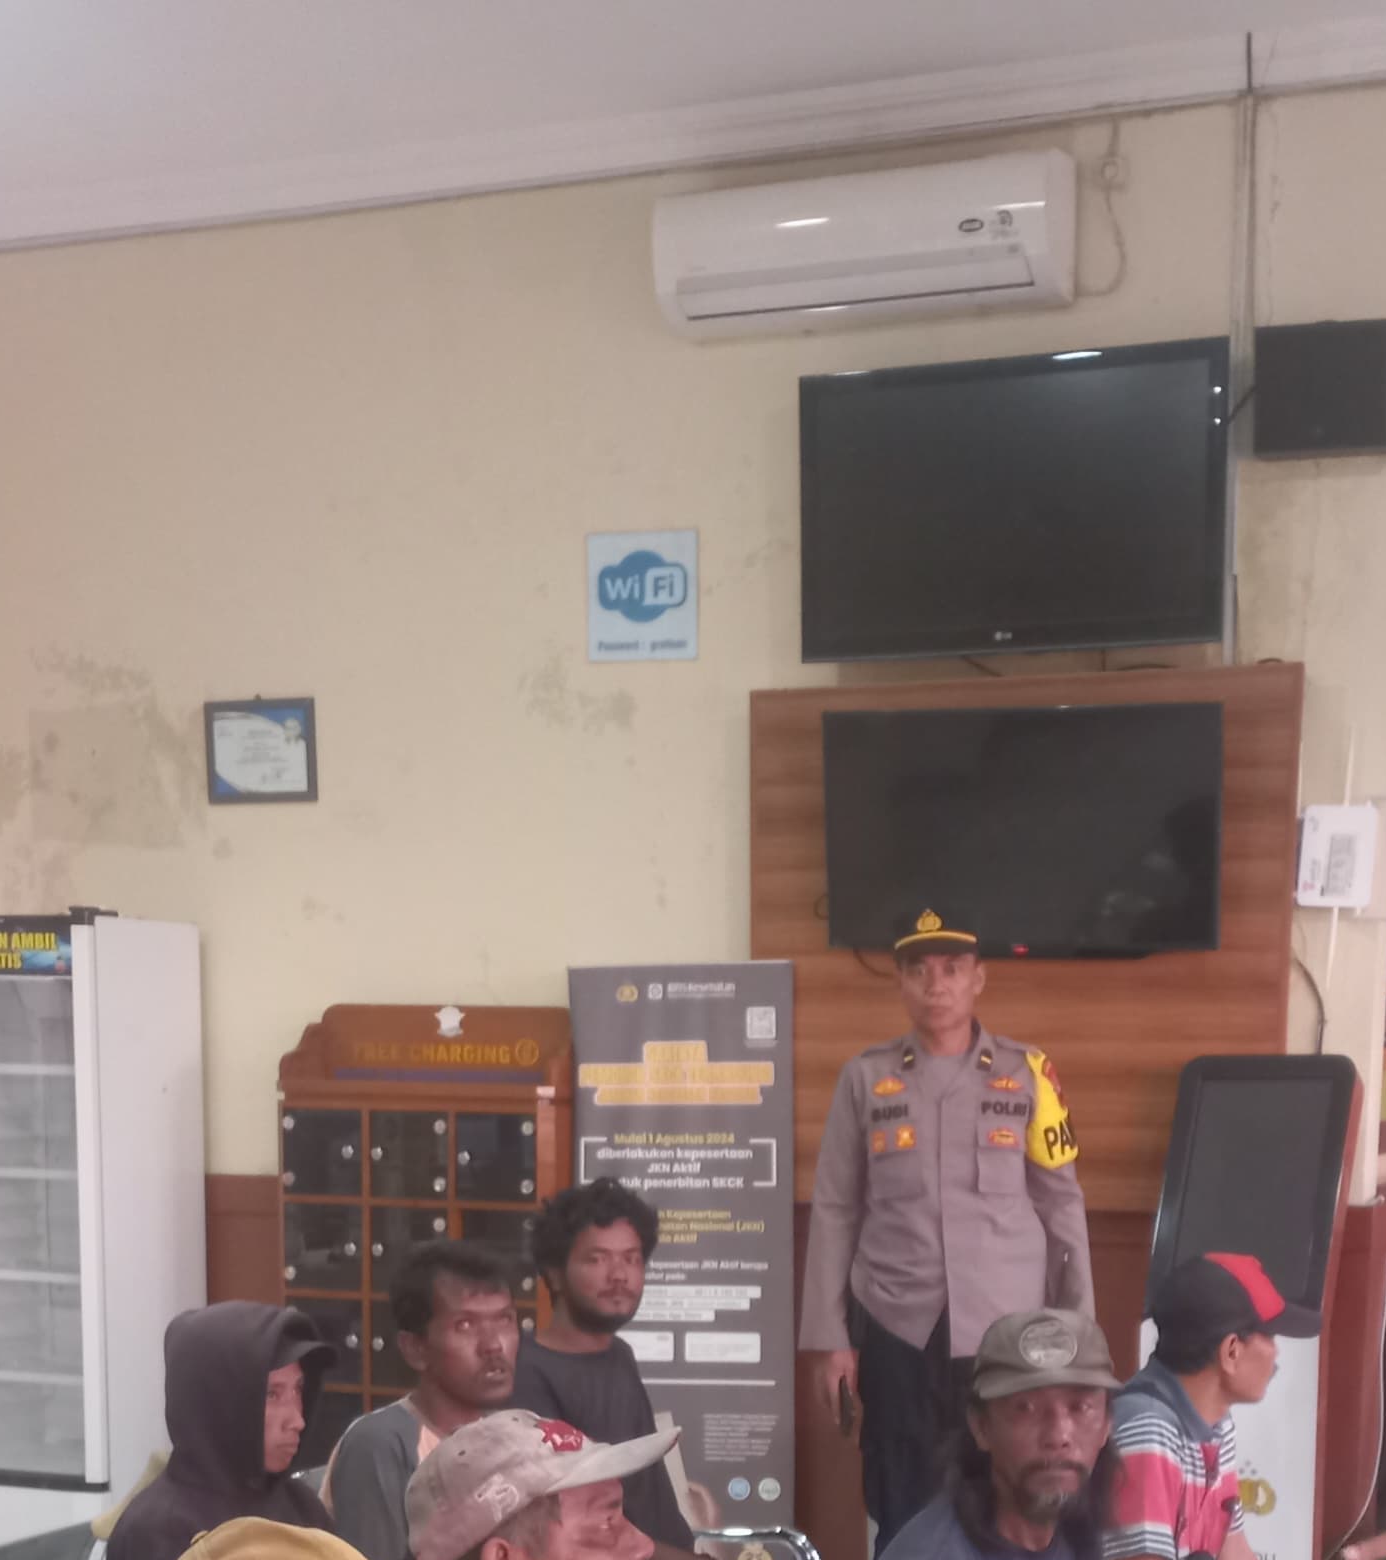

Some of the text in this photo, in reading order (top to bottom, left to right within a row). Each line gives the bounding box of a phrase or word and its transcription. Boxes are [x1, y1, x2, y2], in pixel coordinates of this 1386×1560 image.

[11, 932, 56, 949] AMBIL
[411, 1043, 511, 1064] CHARGING
[614, 1133, 647, 1145] Mulai
[656, 1133, 704, 1147] Agustus
[706, 1133, 735, 1145] 2024
[597, 1148, 753, 1161] diberlakukan kepesertaan
[647, 1162, 701, 1174] JKN Aktif
[644, 1177, 710, 1191] penerbitan
[712, 1177, 744, 1188] SKCK
